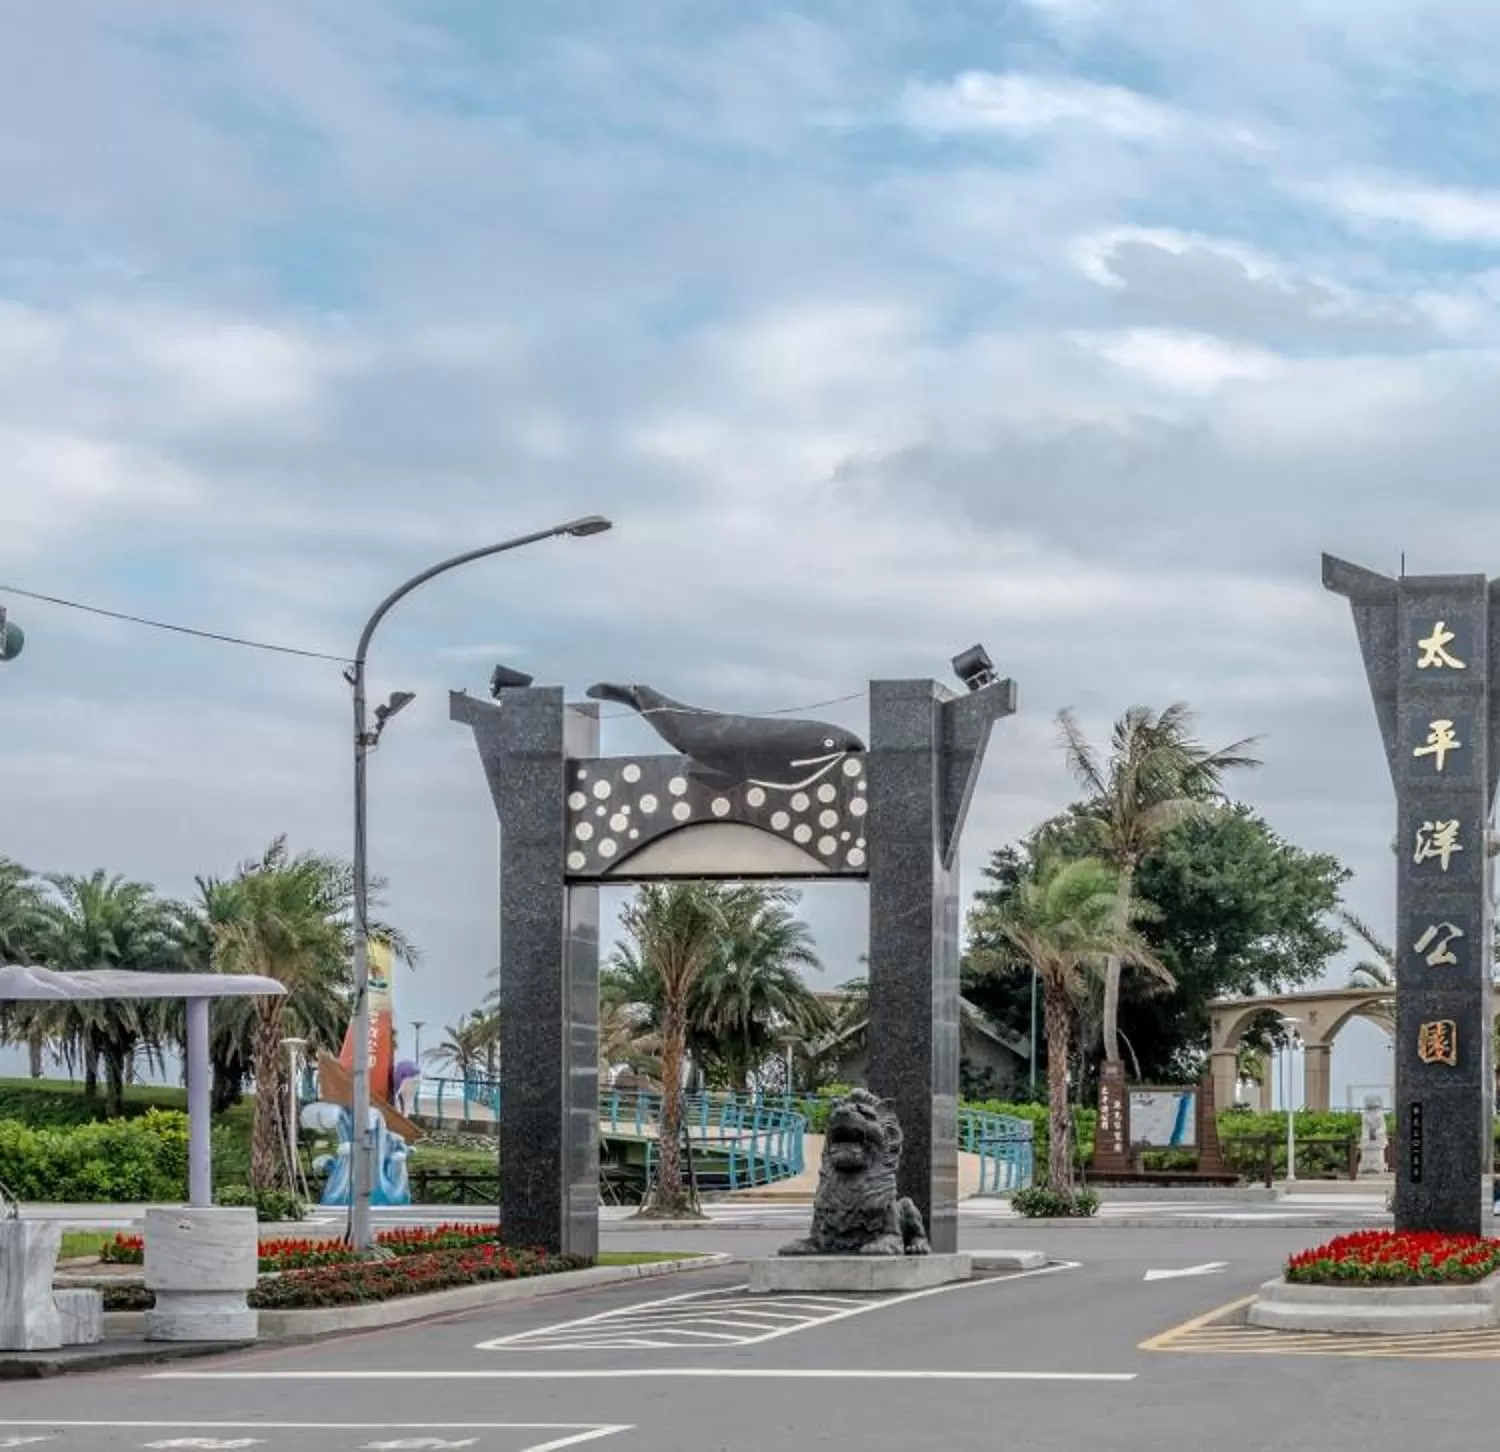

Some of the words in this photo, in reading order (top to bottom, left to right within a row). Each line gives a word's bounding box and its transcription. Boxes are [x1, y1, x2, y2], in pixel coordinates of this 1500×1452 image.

[1412, 620, 1467, 1068] 太平洋公園
